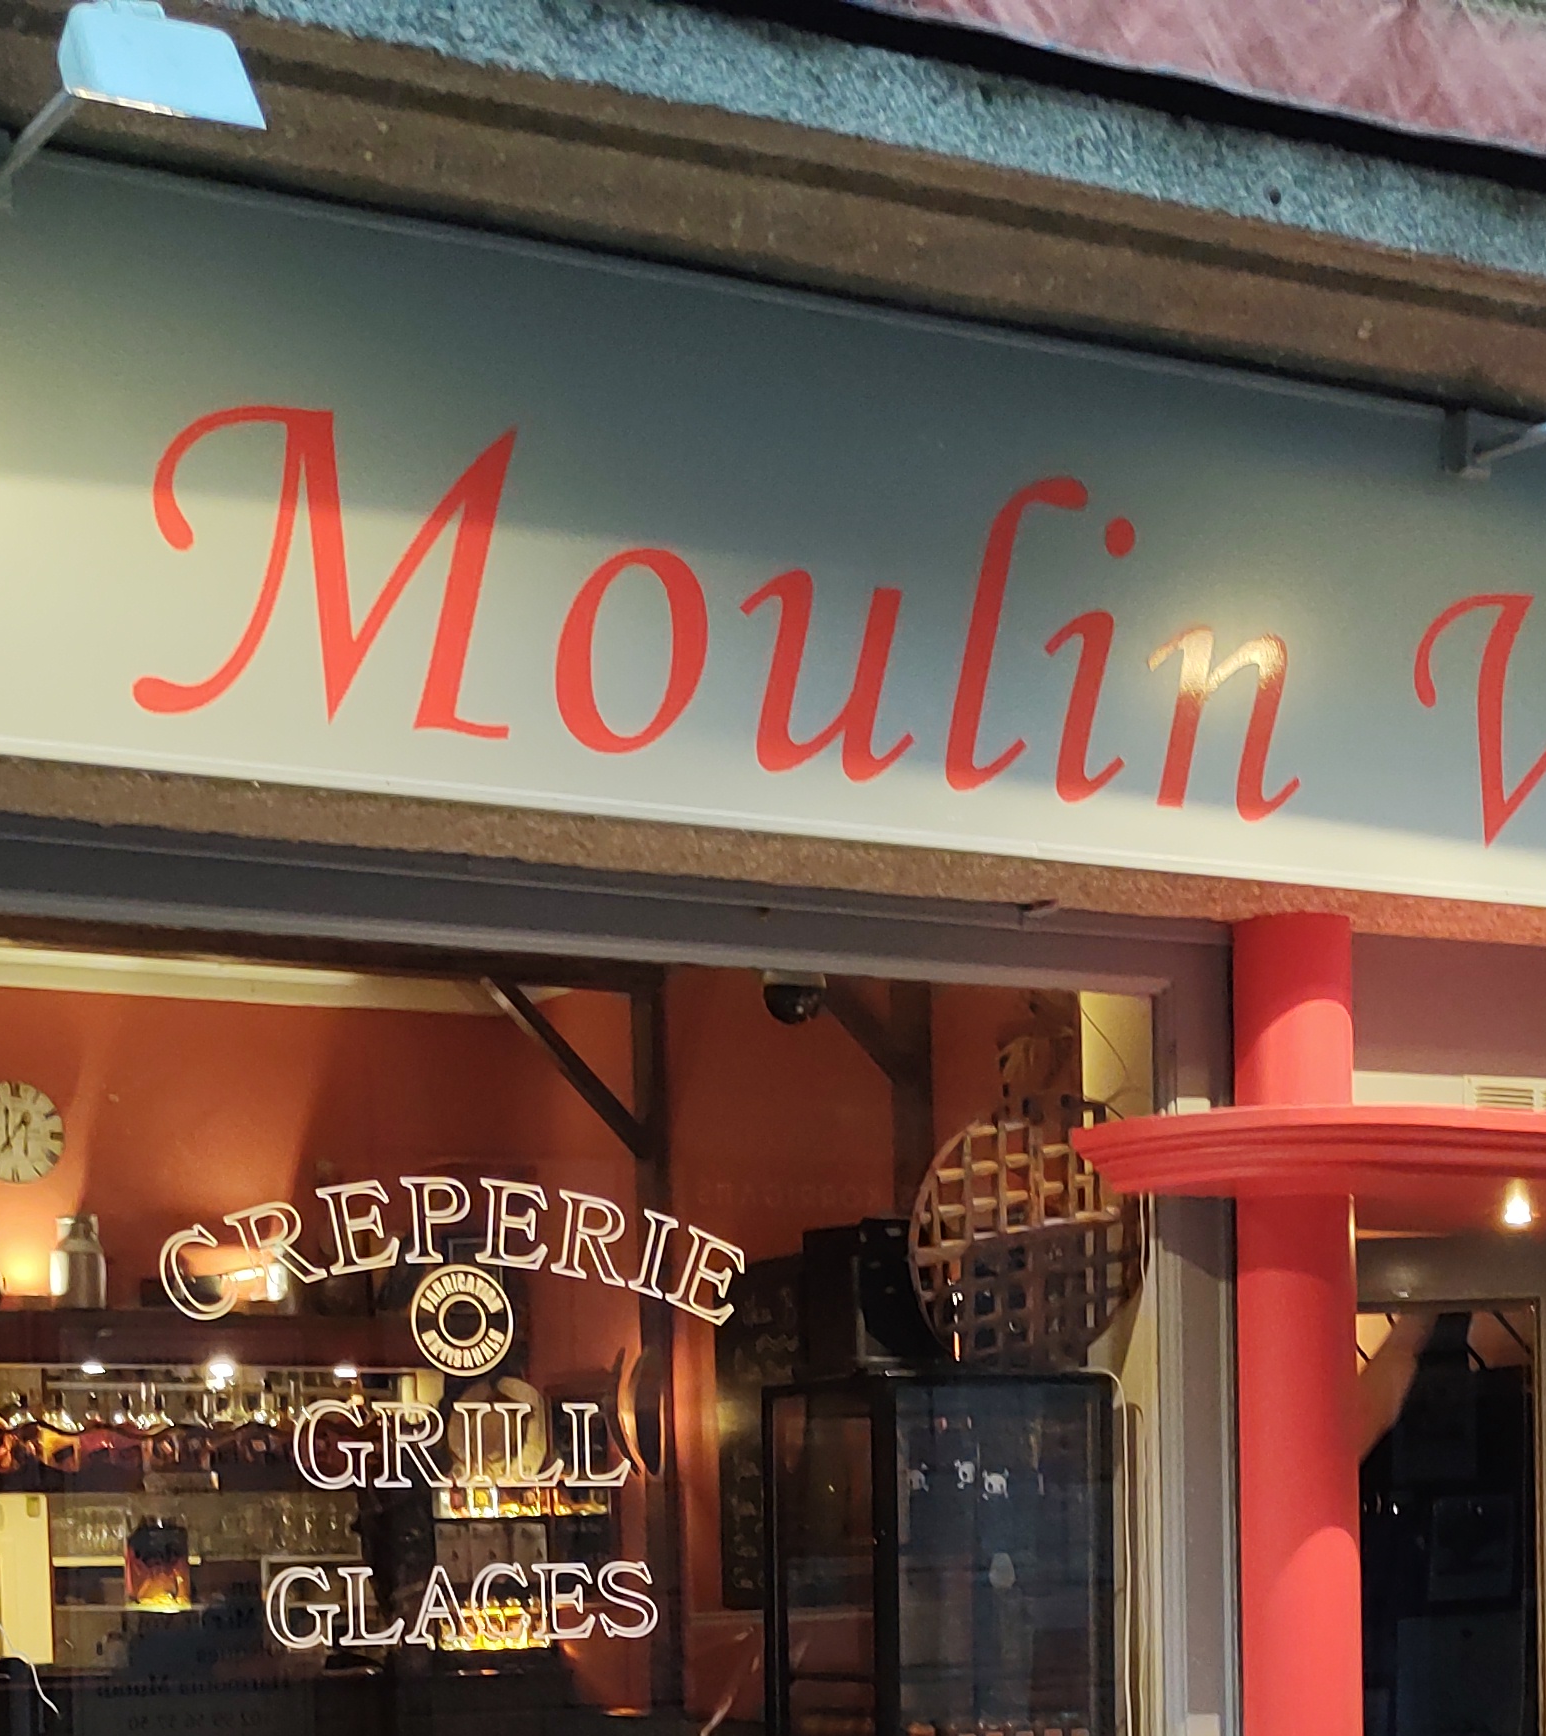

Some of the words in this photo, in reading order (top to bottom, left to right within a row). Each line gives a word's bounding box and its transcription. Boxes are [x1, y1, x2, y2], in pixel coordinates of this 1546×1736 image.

[133, 406, 1301, 822] Moulin
[159, 1175, 746, 1326] CREPERIE
[292, 1400, 633, 1490] GRILL
[265, 1560, 659, 1650] GLACES
